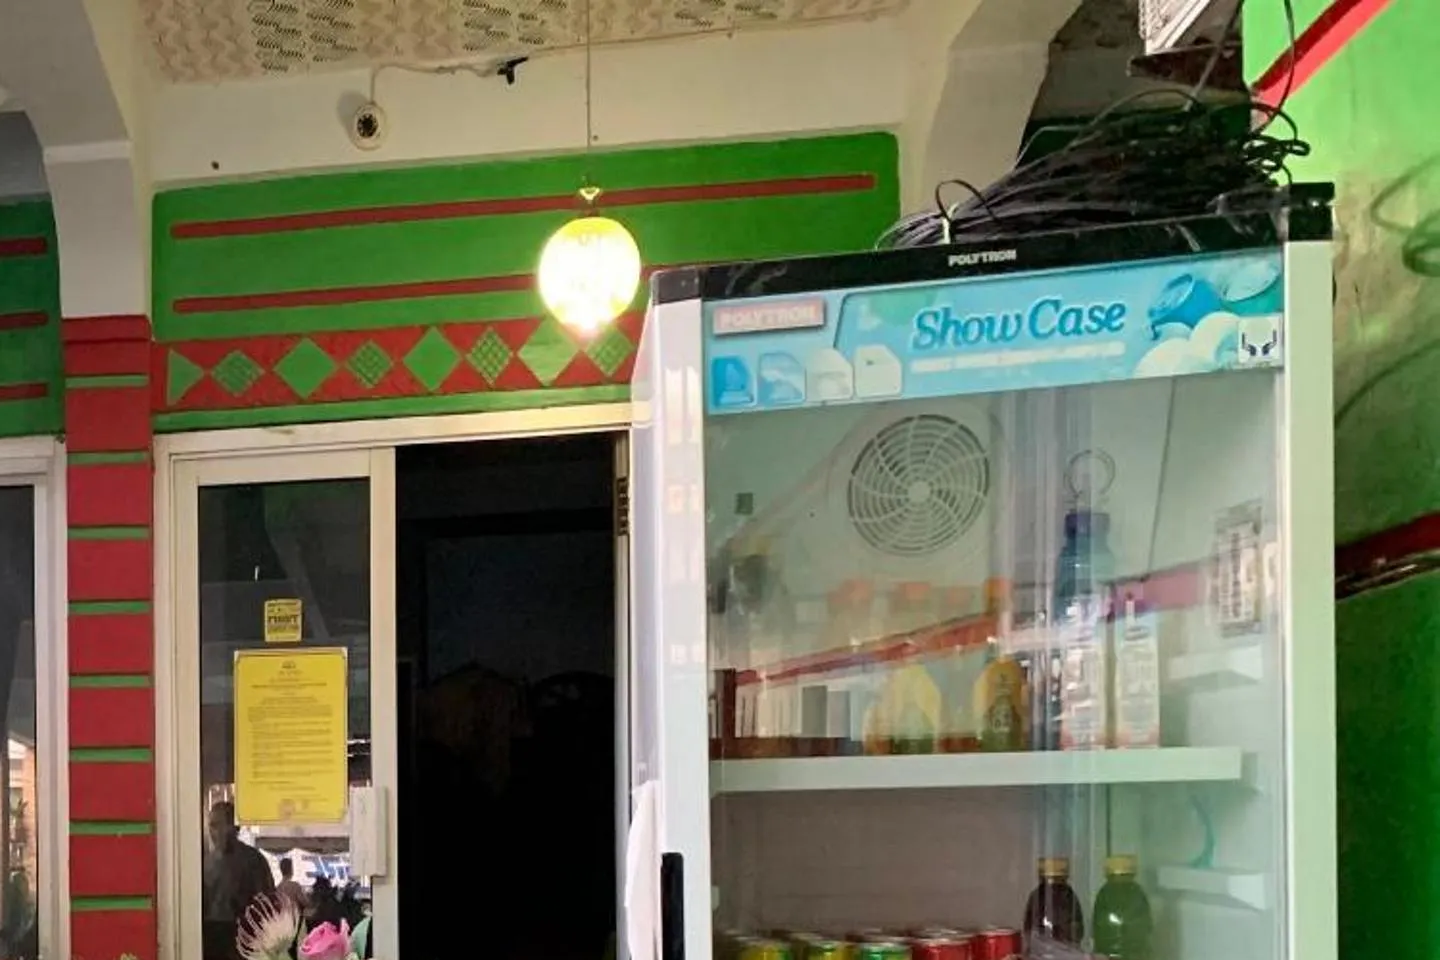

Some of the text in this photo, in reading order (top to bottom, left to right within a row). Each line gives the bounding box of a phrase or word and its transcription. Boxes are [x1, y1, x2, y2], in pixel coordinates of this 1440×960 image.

[948, 249, 1017, 267] POLYTRON
[911, 298, 1126, 350] Show Case
